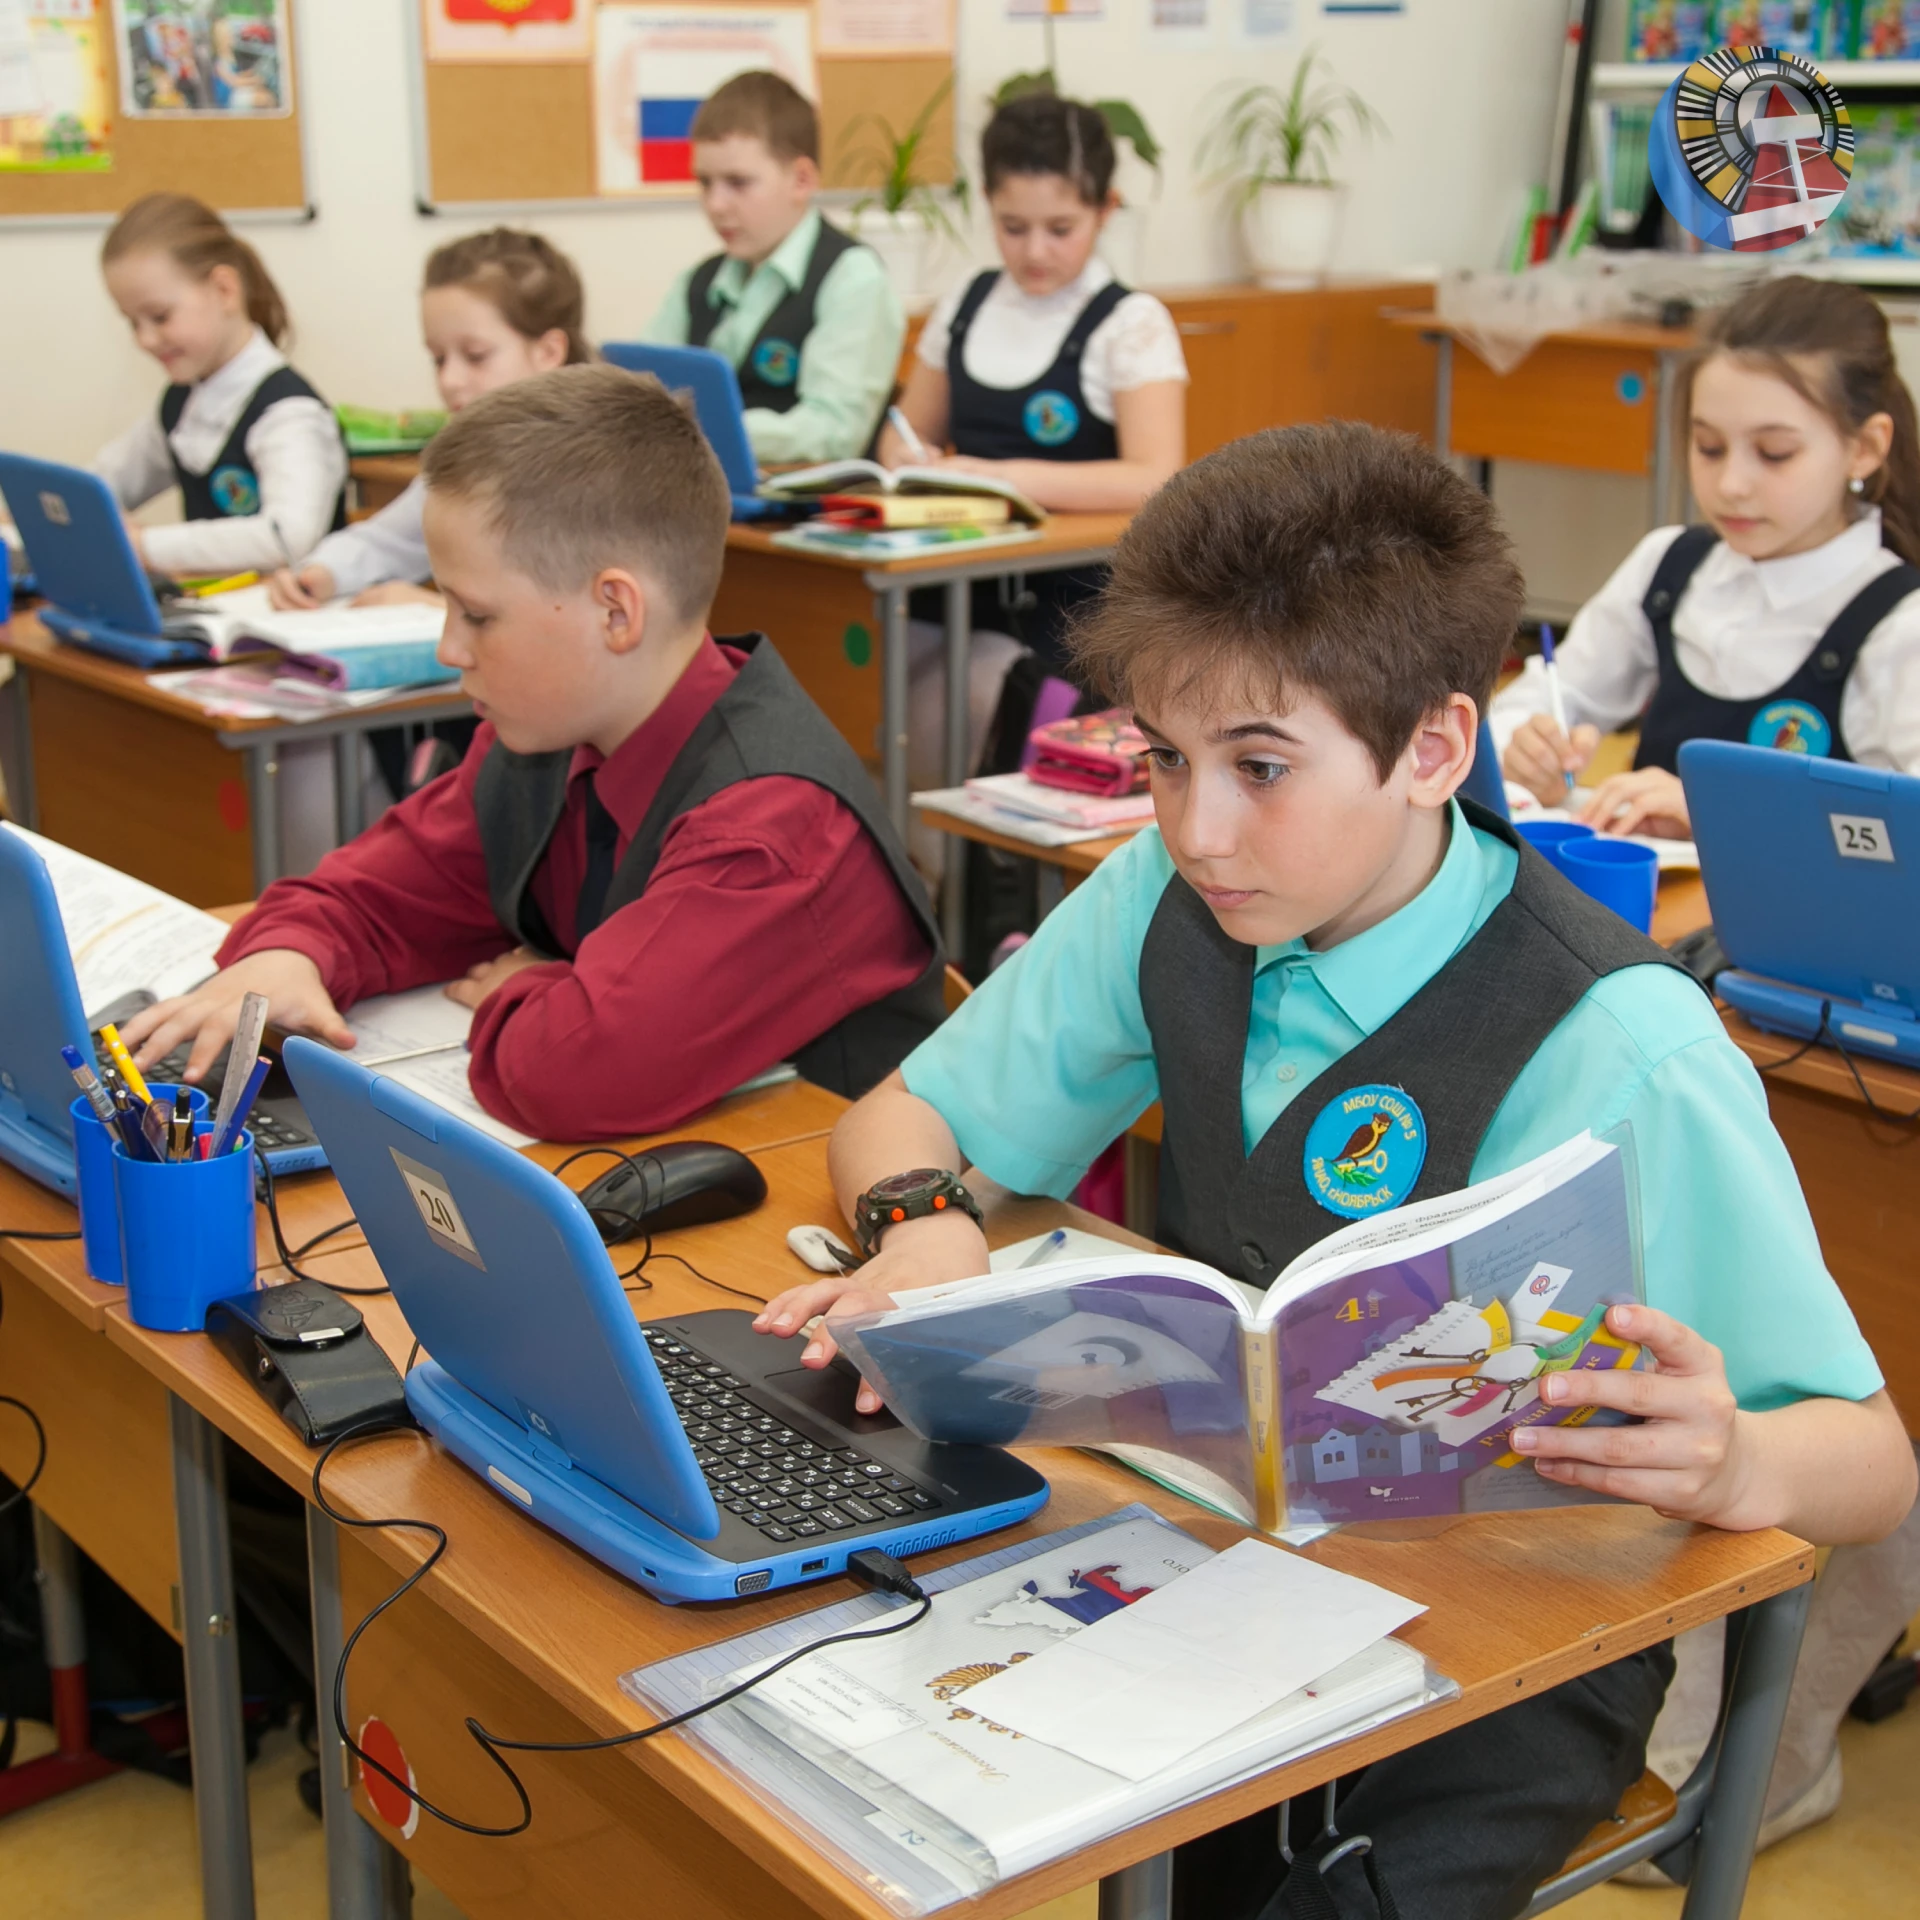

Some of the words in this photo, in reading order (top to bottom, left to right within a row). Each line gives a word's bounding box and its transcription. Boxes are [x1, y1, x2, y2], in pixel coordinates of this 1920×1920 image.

[1840, 823, 1878, 852] 25
[1341, 1093, 1379, 1114] МБОУ
[1379, 1095, 1407, 1117] СОШ
[1403, 1129, 1418, 1141] 5
[419, 1188, 455, 1234] 20
[1335, 1297, 1365, 1322] 4
